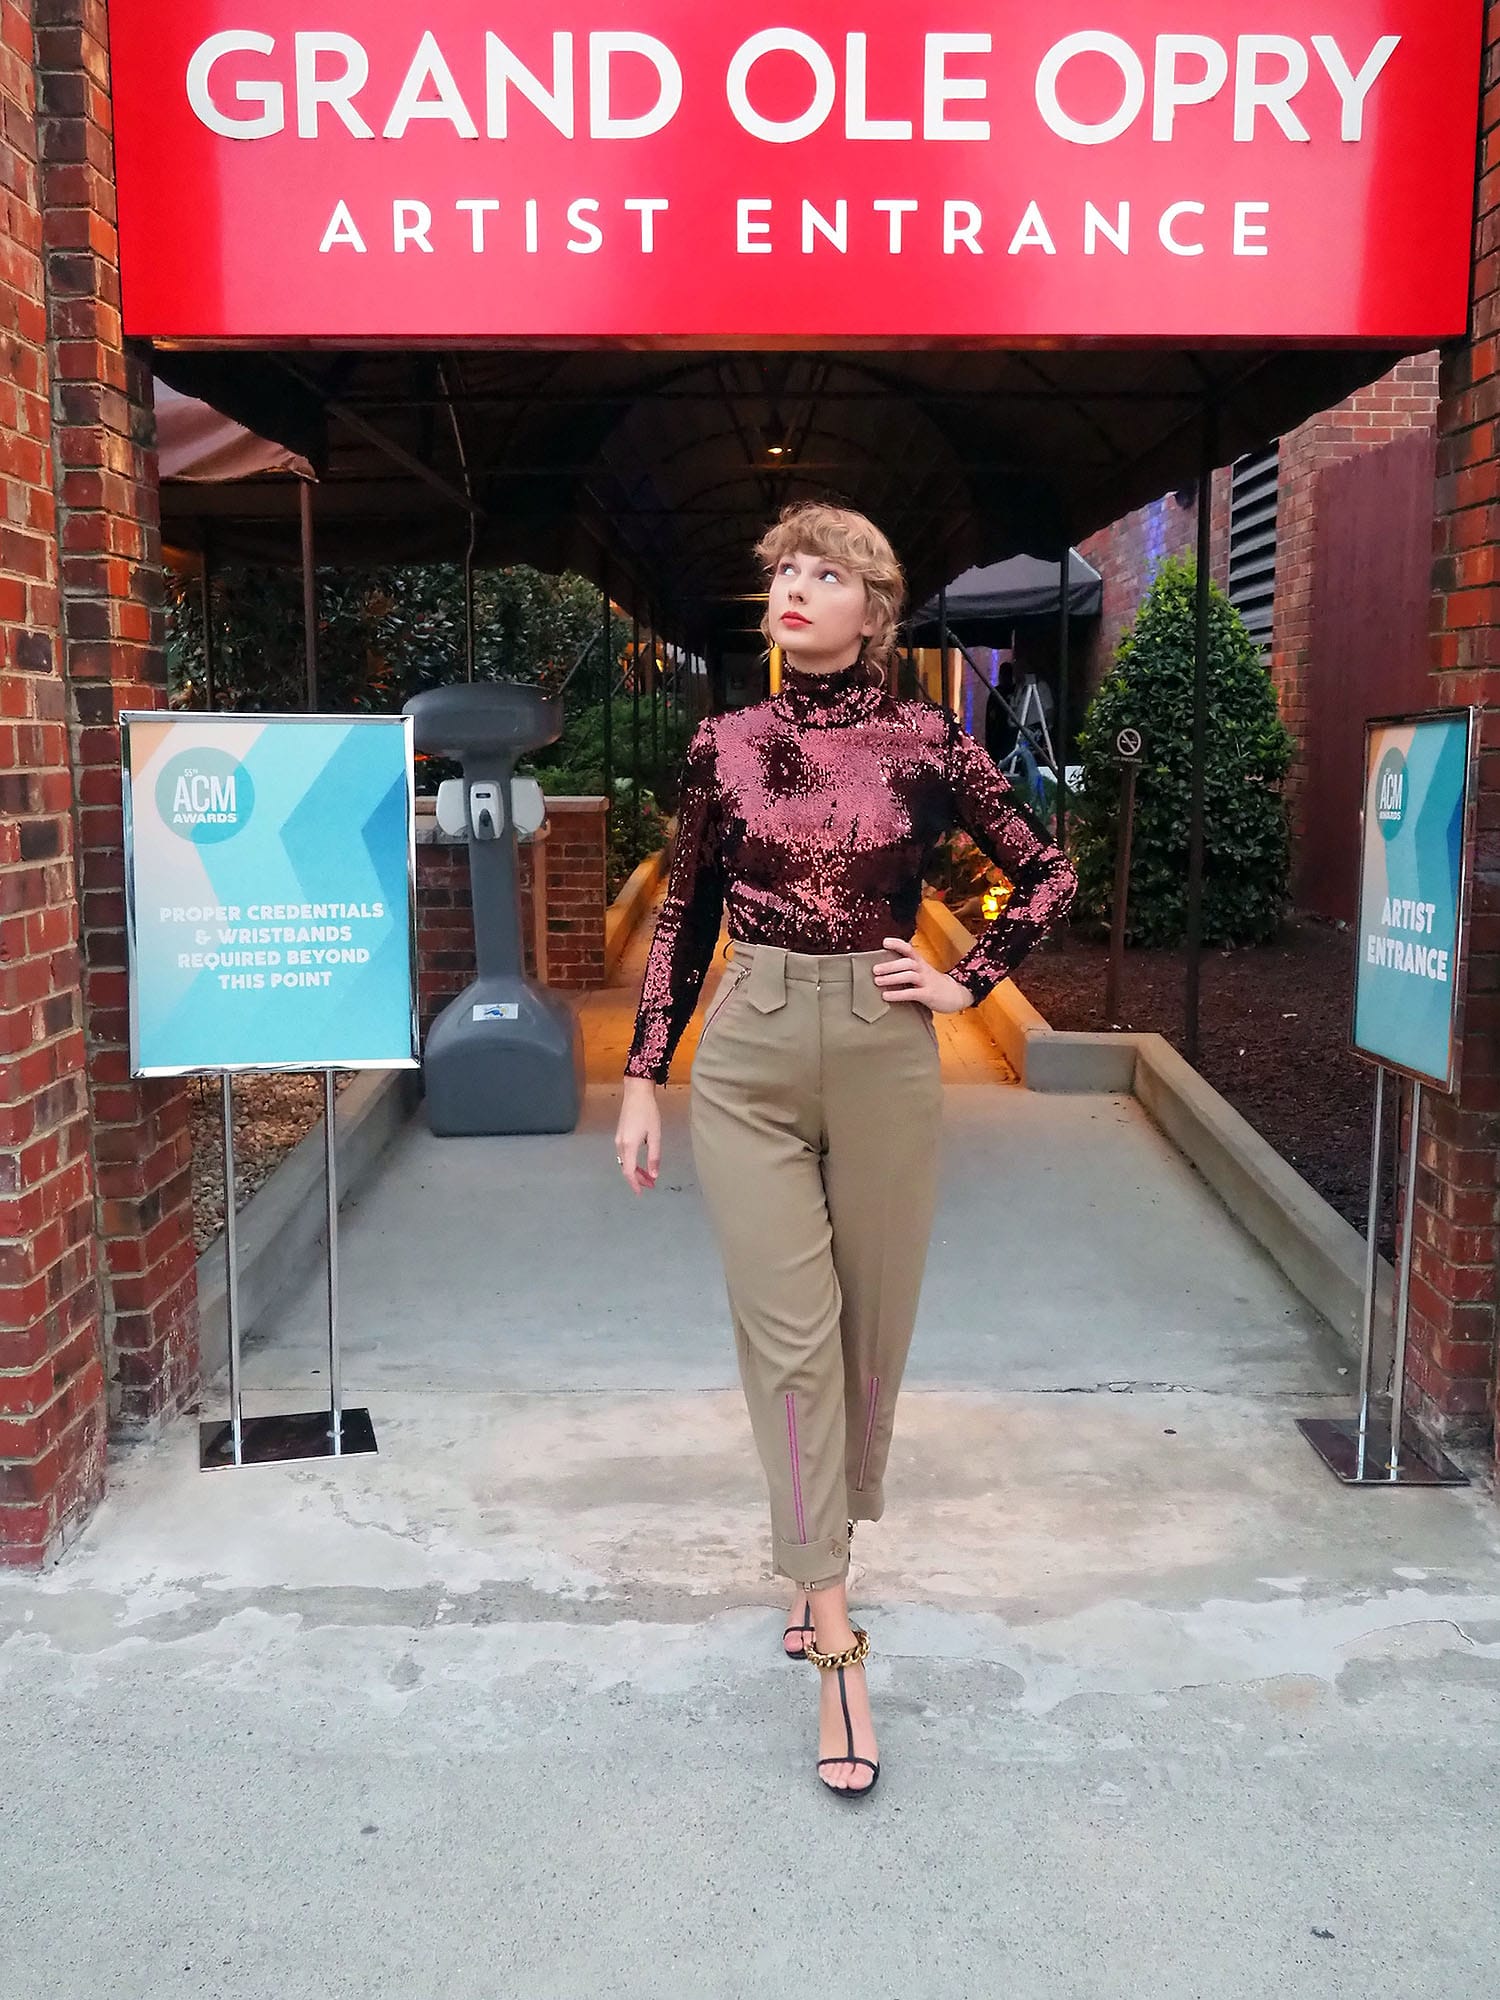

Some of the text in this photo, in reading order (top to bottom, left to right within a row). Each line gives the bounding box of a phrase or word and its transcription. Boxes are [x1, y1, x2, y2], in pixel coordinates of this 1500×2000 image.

[186, 28, 1402, 145] GRAND OLE OPRY
[318, 198, 1270, 257] ARTIST ENTRANCE
[173, 775, 237, 812] ACM
[1379, 773, 1403, 810] ACM
[172, 813, 237, 824] AWARDS
[159, 903, 385, 923] PROPER CREDENTIALS
[1381, 897, 1436, 934] ARTIST
[195, 926, 353, 946] & WRISTBANDS
[177, 949, 370, 971] REQUIRED BEYOND
[1367, 934, 1448, 982] ENTRANCE
[218, 971, 333, 990] THIS POINT
